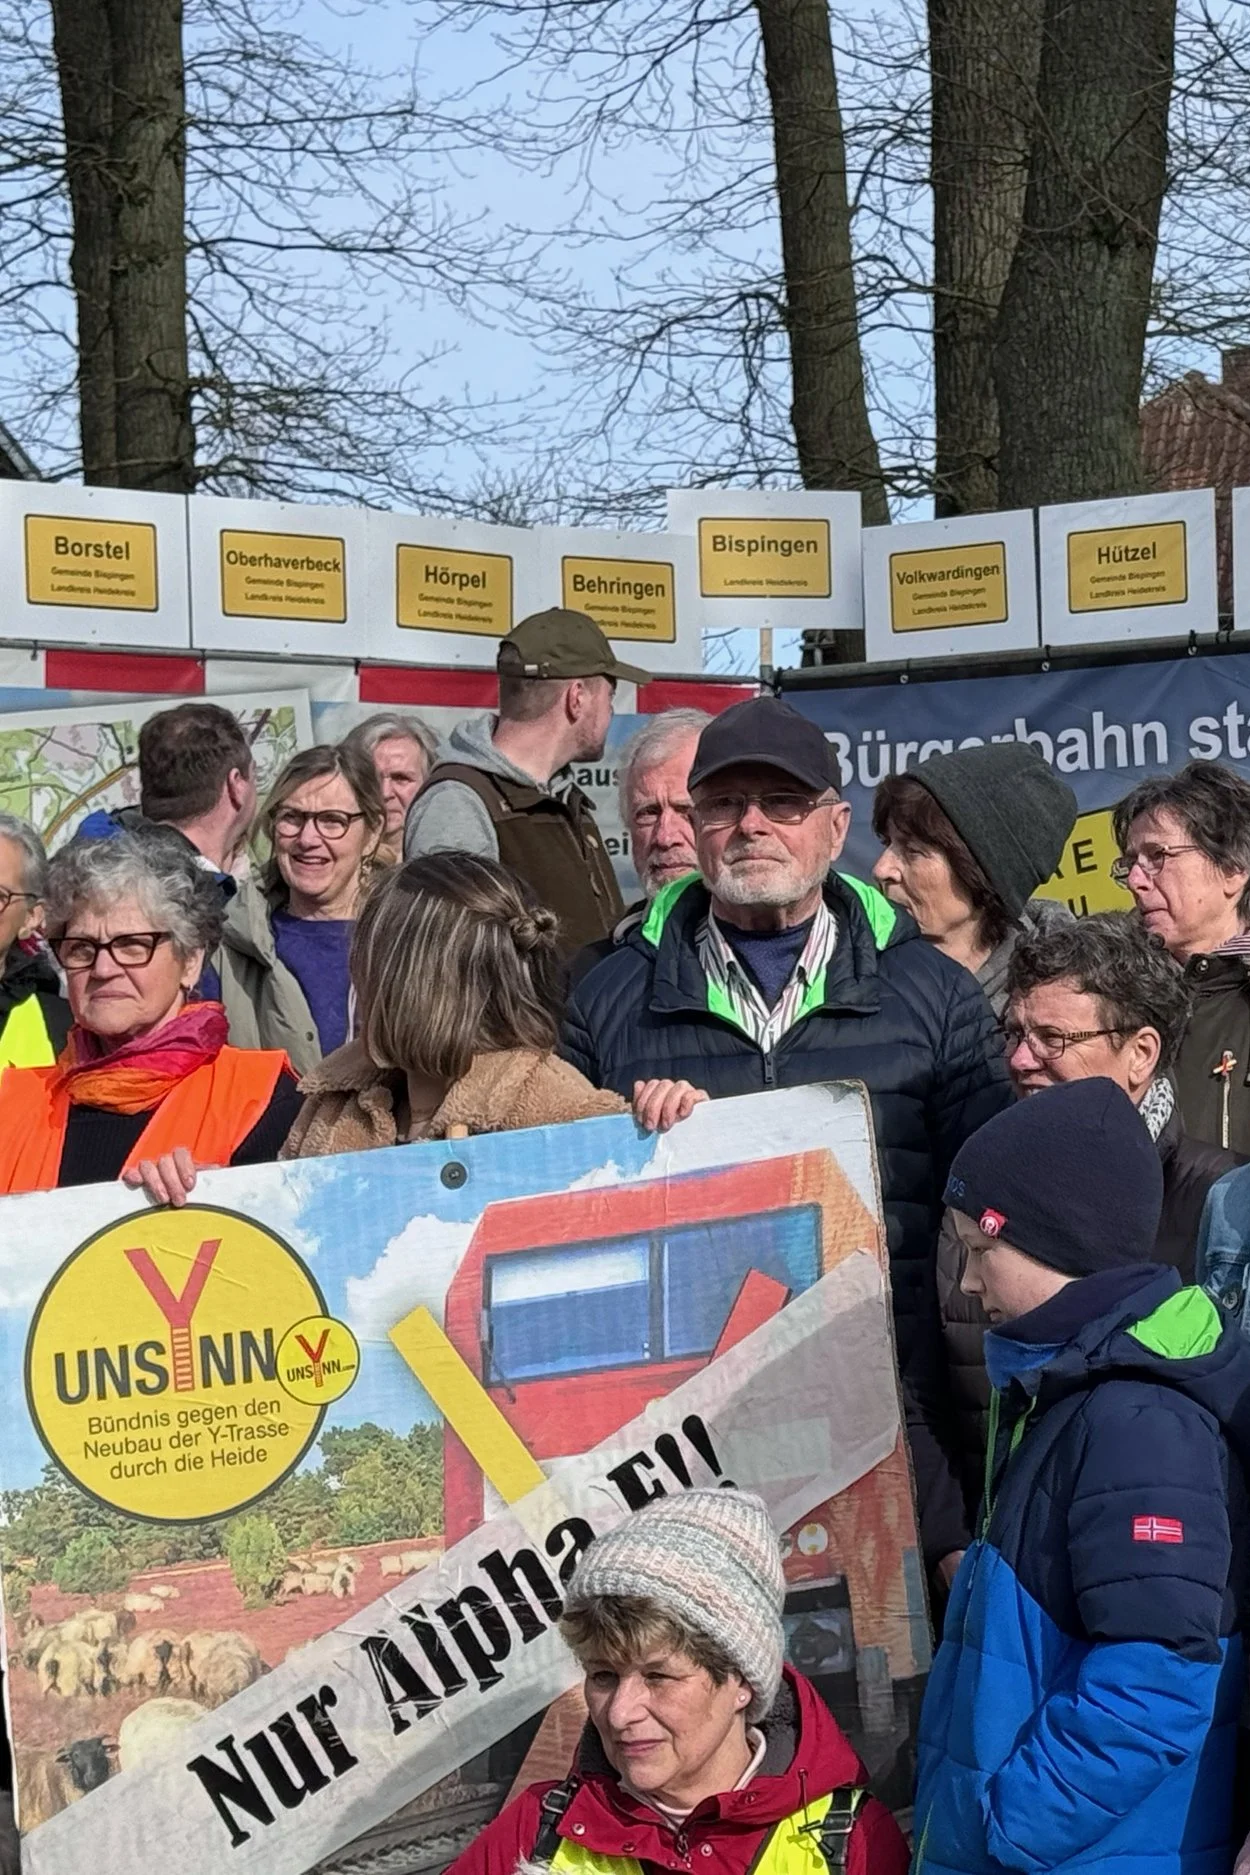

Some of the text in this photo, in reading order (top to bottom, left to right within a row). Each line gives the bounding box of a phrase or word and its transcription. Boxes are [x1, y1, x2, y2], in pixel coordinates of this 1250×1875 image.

[54, 536, 130, 560] Borstel
[712, 535, 818, 557] Bispingen
[1098, 541, 1157, 565] Hützel
[226, 550, 341, 573] Oberhaverbeck
[896, 564, 1001, 585] Volkwardingen
[424, 565, 487, 591] Hörpel
[573, 574, 666, 600] Behringen
[88, 1399, 281, 1436] Bündnis gegen den
[84, 1422, 290, 1459] Neubau der Y-Trasse
[110, 1446, 268, 1480] durch die Heide
[187, 1684, 358, 1849] Nur
[360, 1517, 596, 1736] Alpha
